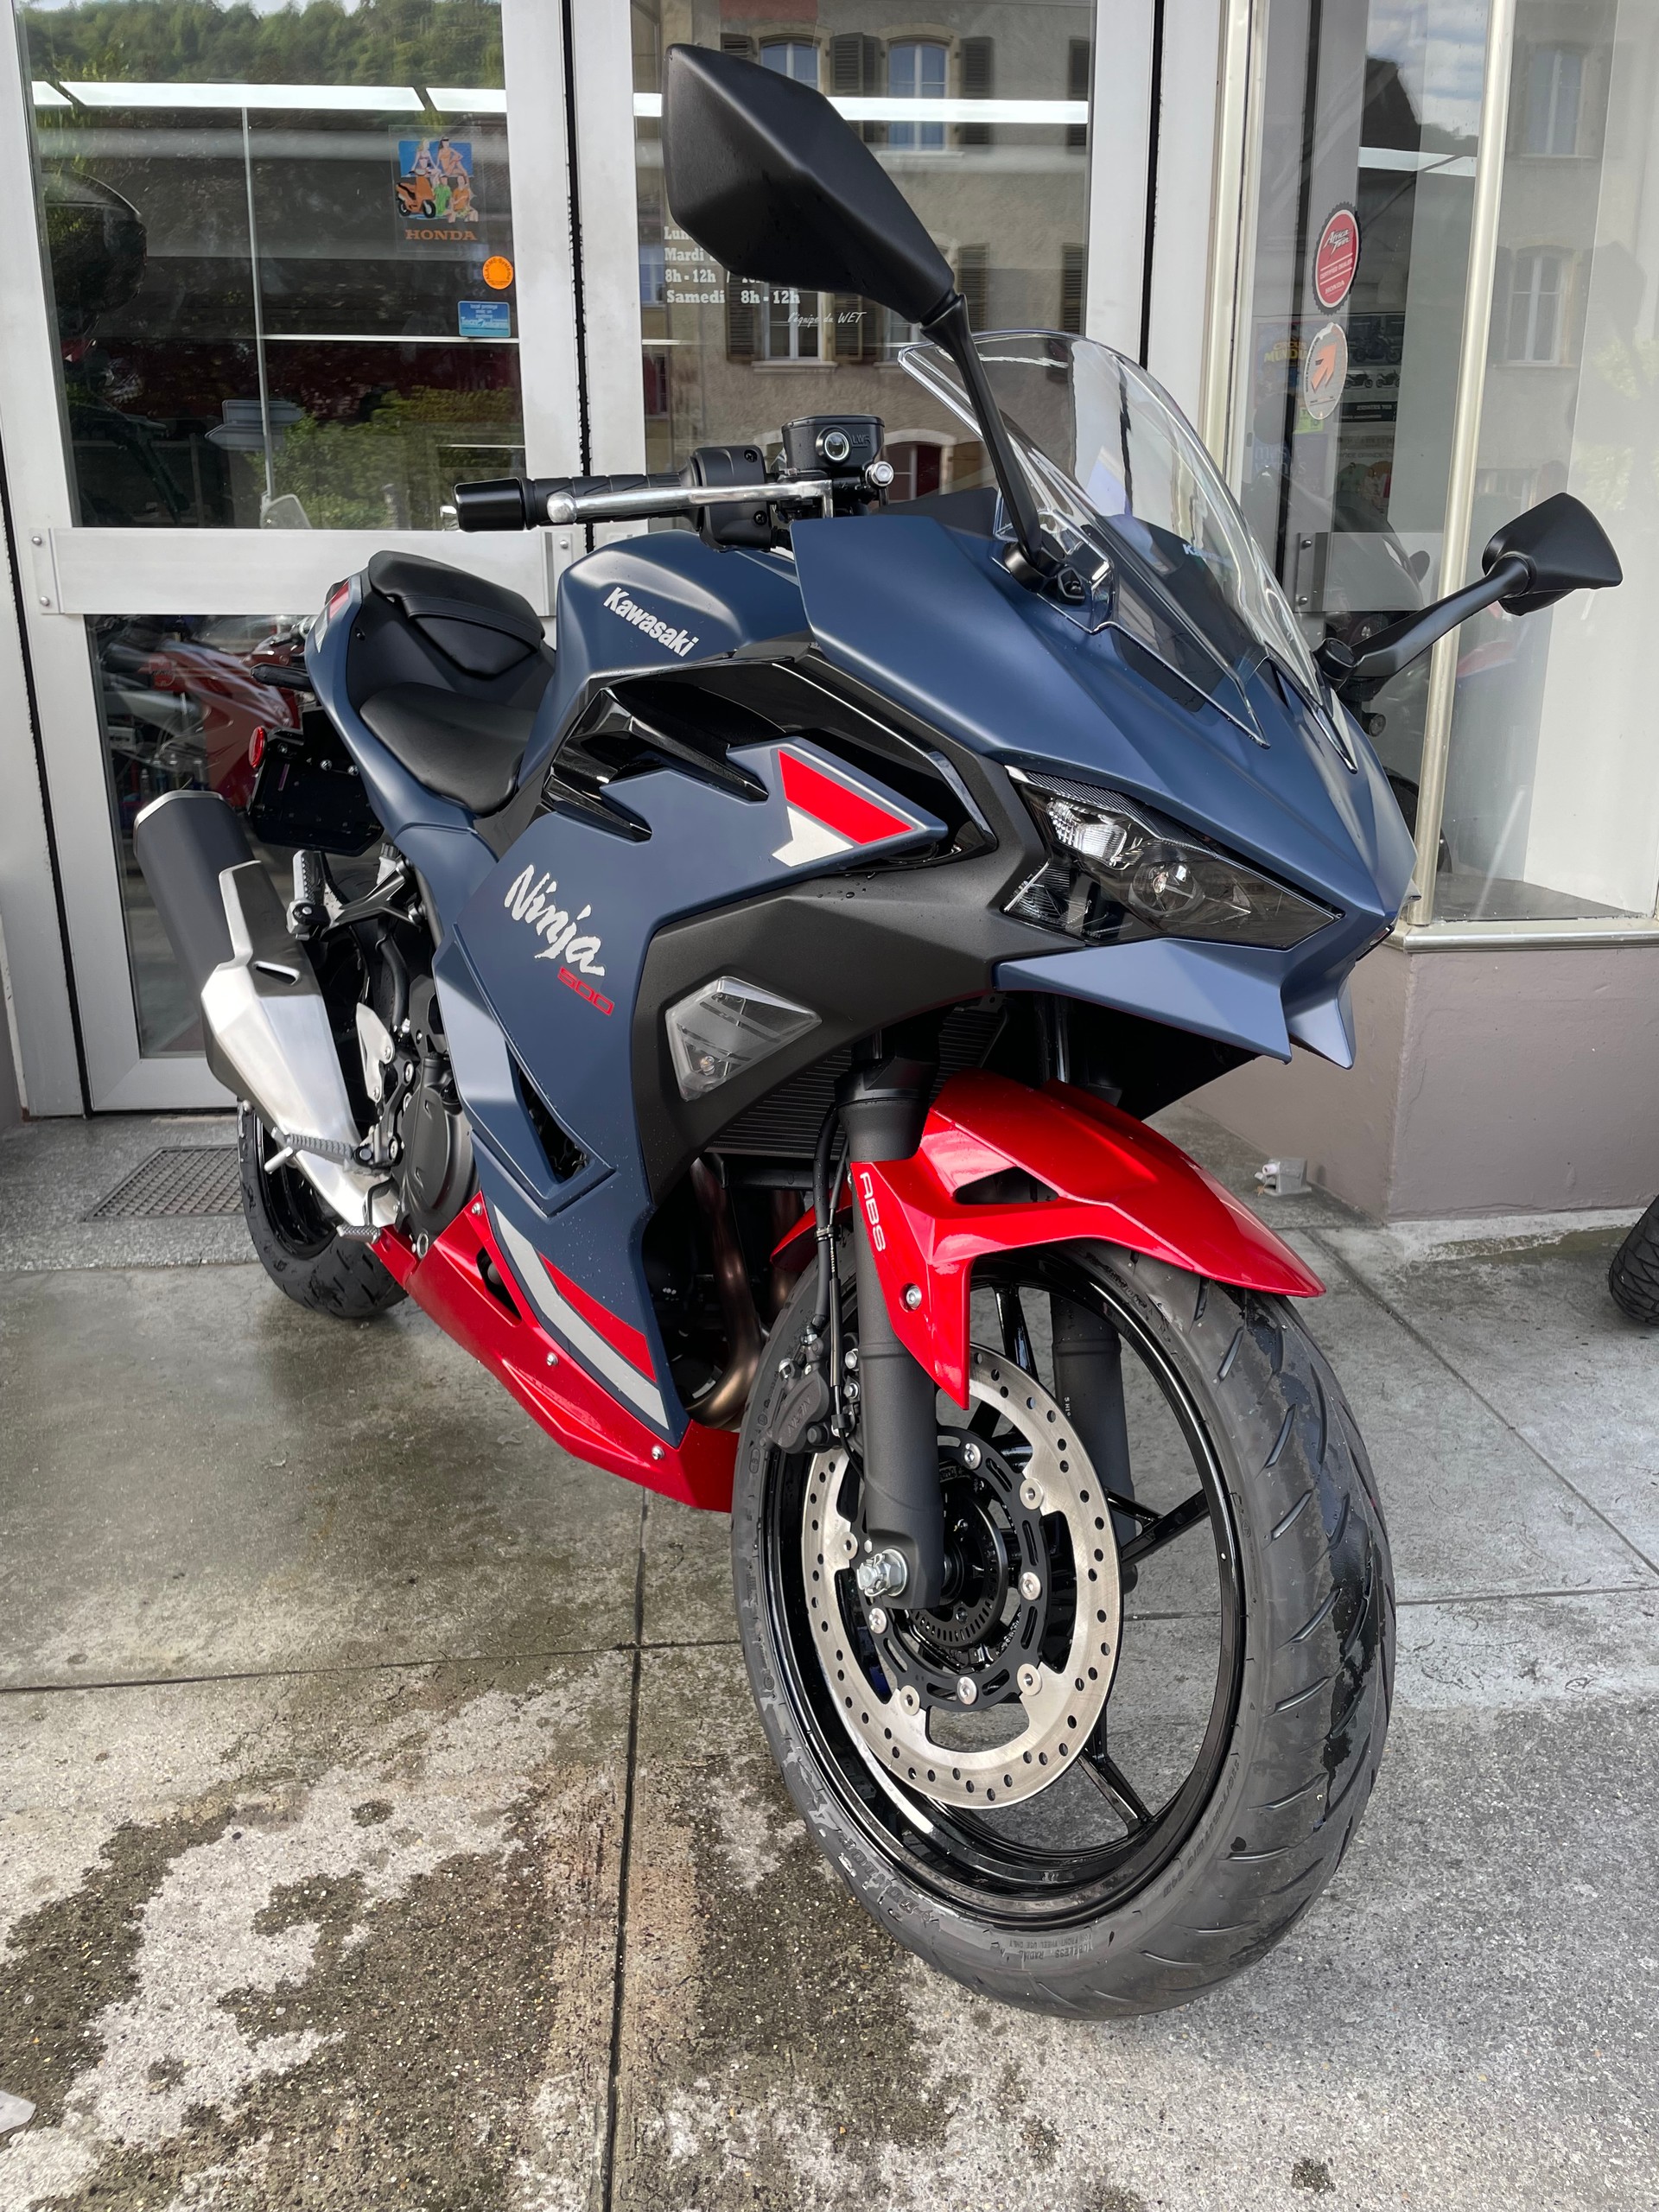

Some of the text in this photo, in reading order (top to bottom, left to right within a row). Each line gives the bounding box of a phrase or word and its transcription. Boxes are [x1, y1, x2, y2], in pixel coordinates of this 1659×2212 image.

[404, 229, 478, 241] HONDA
[664, 226, 693, 240] Lun
[664, 247, 704, 261] Mardi
[665, 269, 682, 283] 8h
[693, 269, 716, 283] 12h
[1325, 280, 1345, 294] HONDA
[666, 289, 726, 303] Samedi
[741, 290, 760, 303] 8h
[773, 290, 800, 303] 12h
[823, 313, 834, 322] du
[838, 312, 867, 323] WET
[603, 587, 699, 657] Kawasaki
[505, 864, 605, 976] Ninja
[557, 966, 614, 1016] 500
[860, 1172, 886, 1252] ABS
